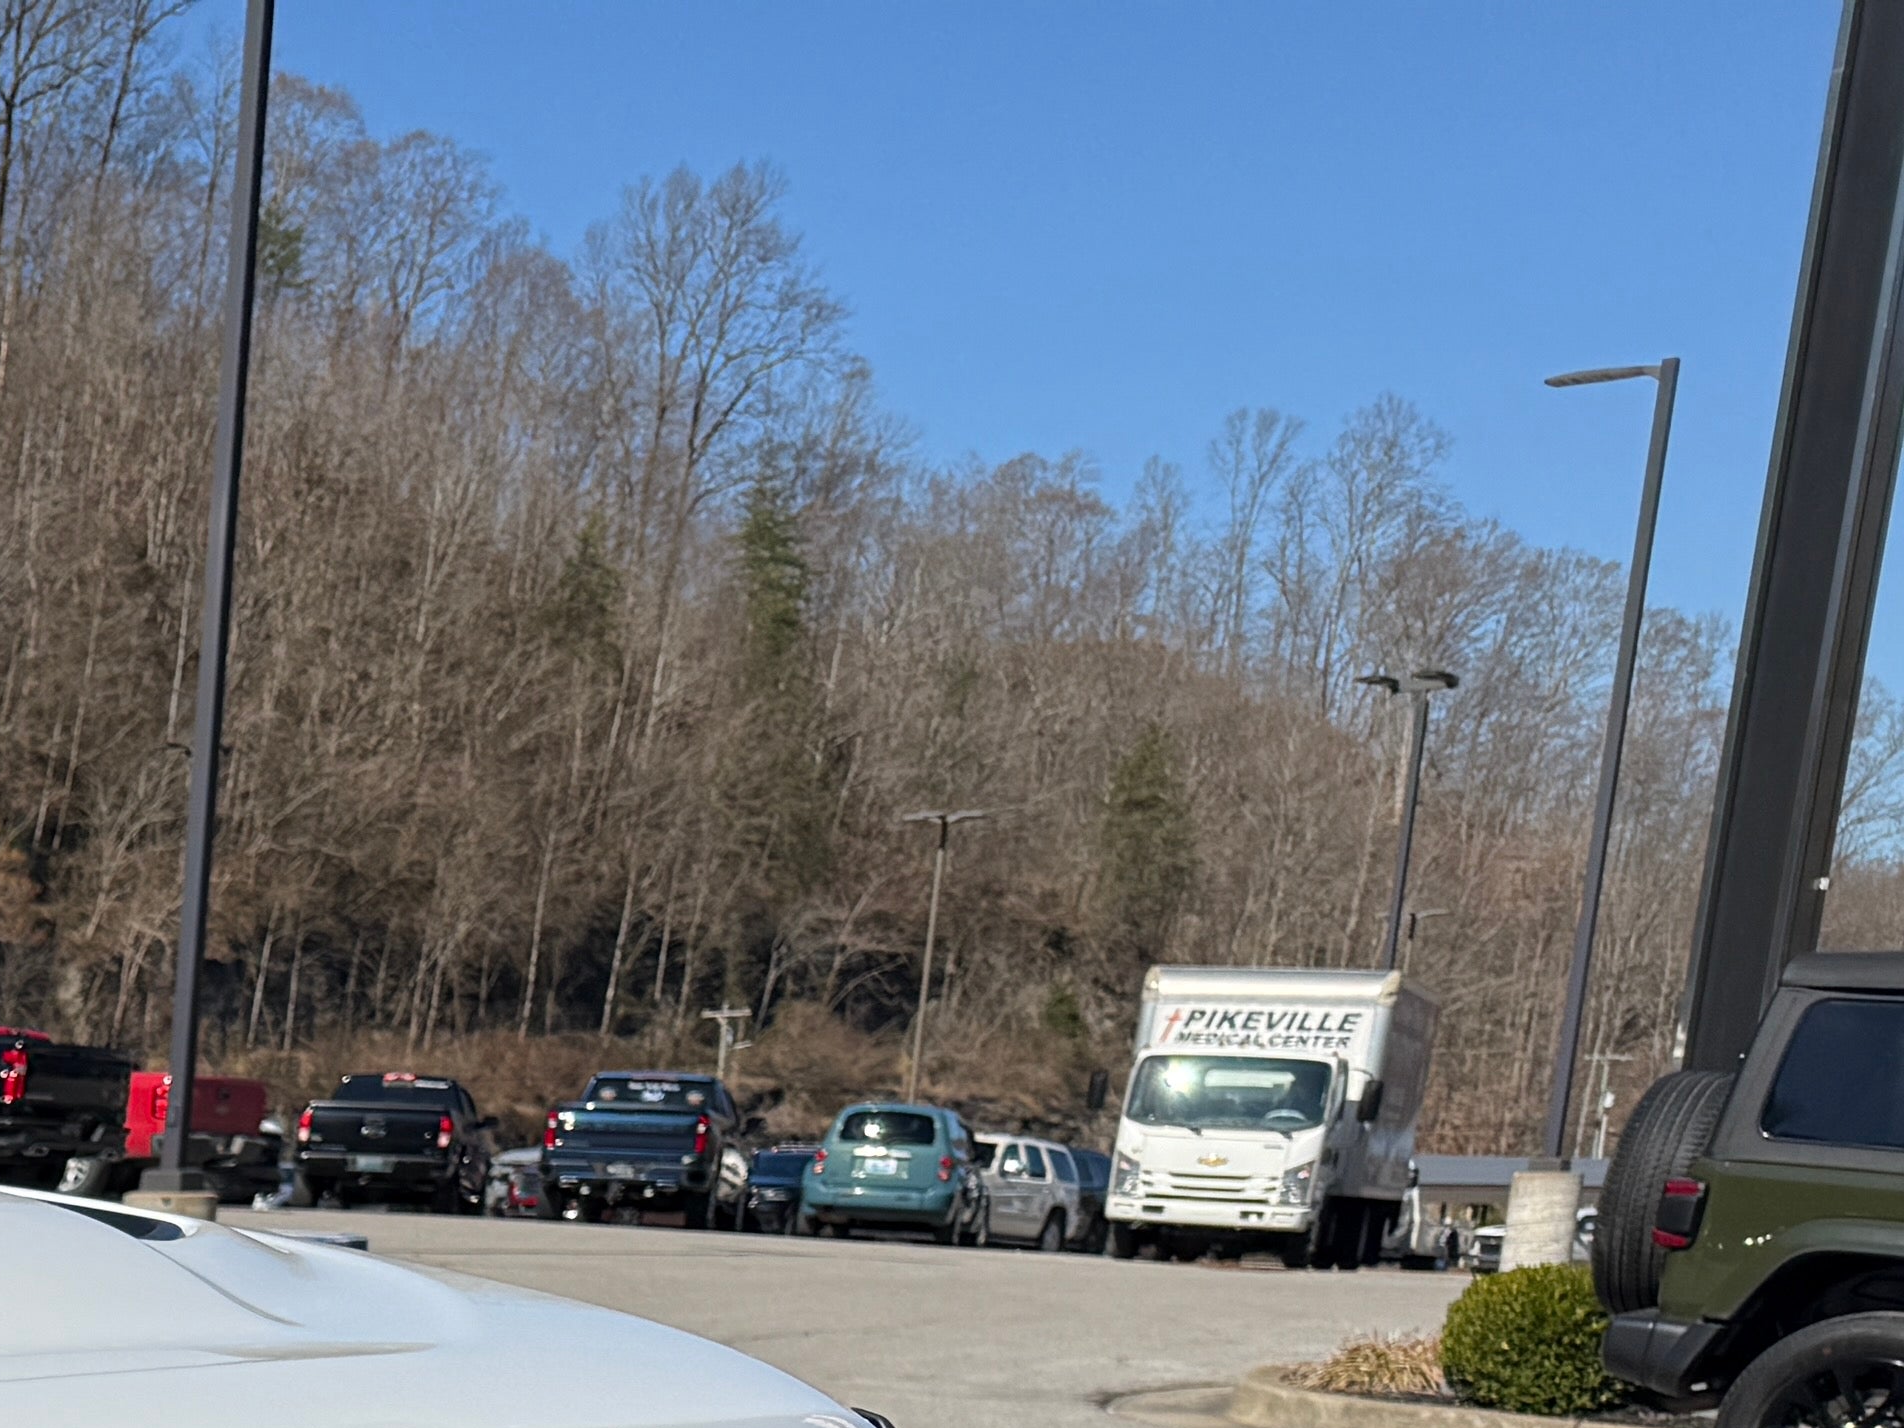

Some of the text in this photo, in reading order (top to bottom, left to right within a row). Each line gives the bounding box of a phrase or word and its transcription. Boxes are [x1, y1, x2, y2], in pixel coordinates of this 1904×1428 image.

[1183, 1009, 1363, 1033] PIKEVILLE
[1175, 1031, 1351, 1049] MEDICAL CENTER
